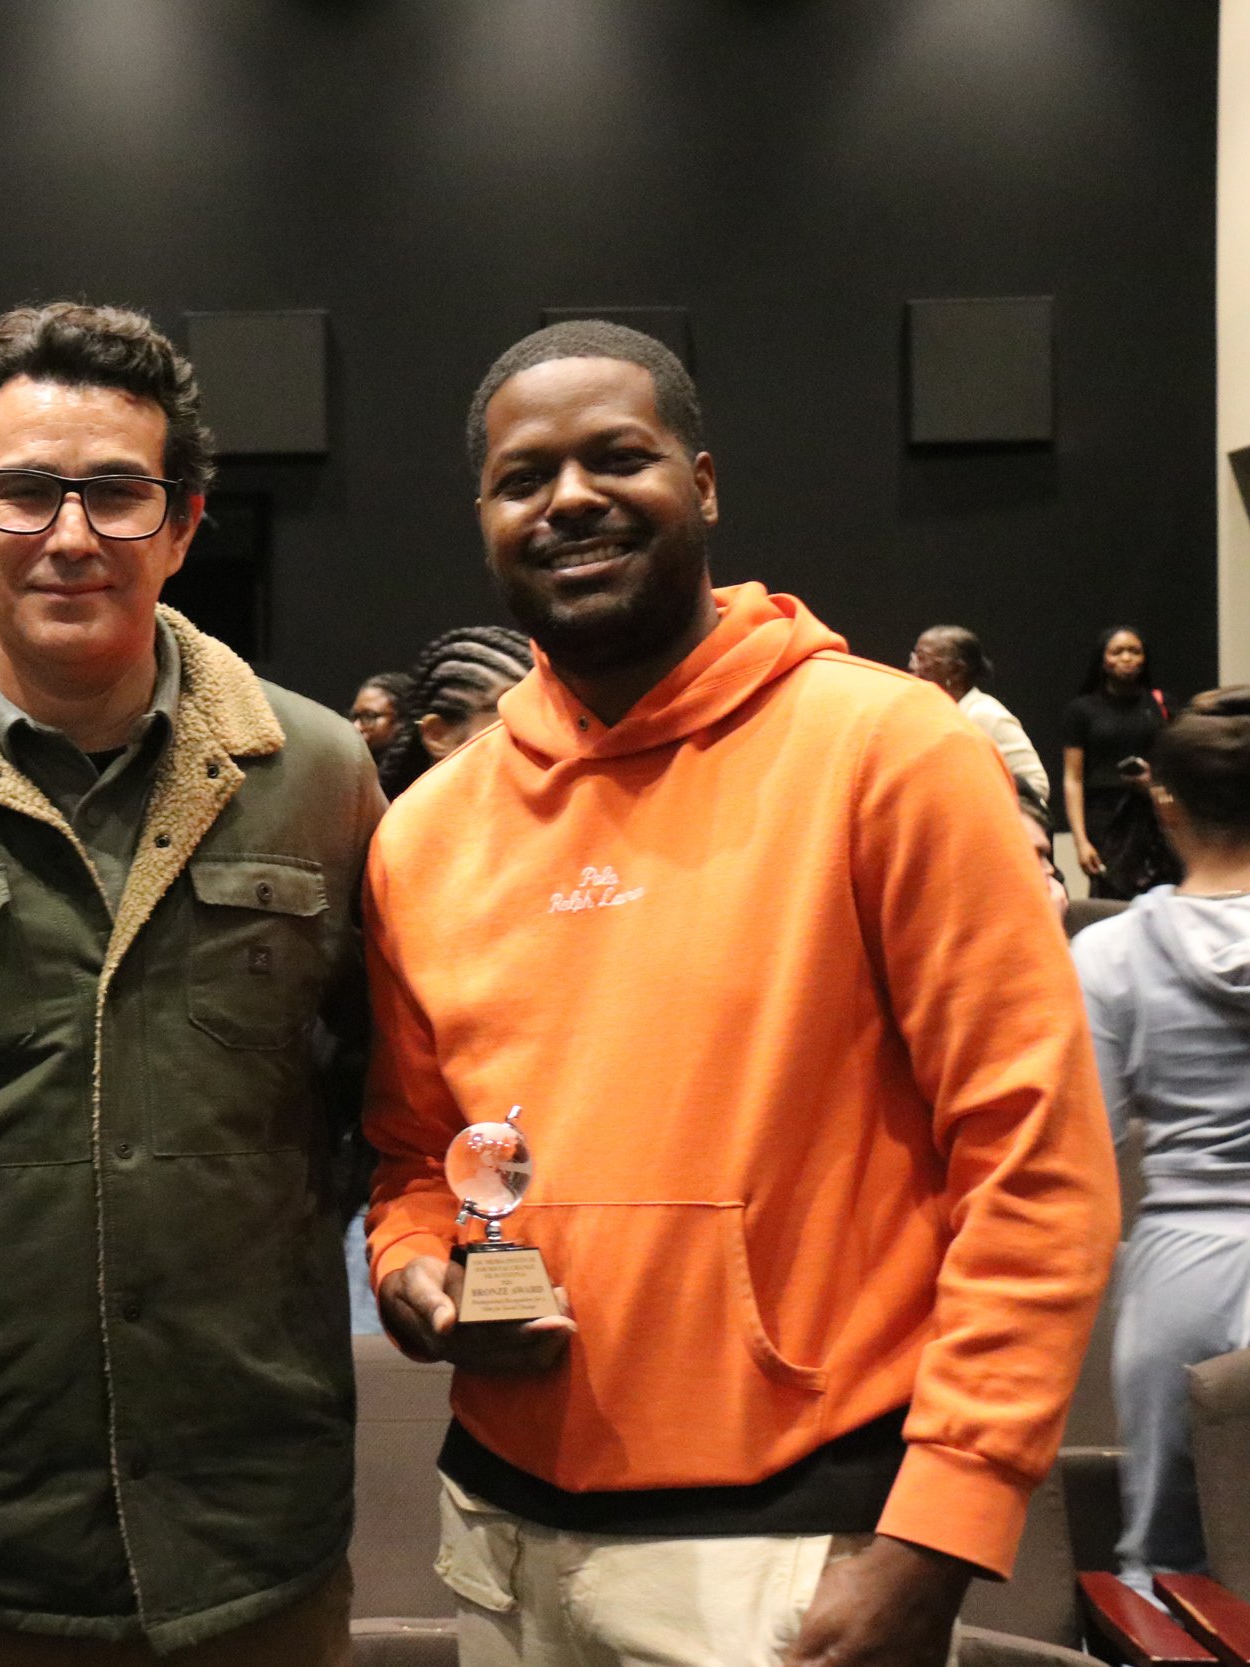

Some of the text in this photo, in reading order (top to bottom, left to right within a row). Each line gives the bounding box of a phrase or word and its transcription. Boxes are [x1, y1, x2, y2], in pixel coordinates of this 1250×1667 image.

[578, 865, 619, 888] Polo
[548, 889, 595, 914] Ralph
[471, 1285, 544, 1297] BRONZE AWARD
